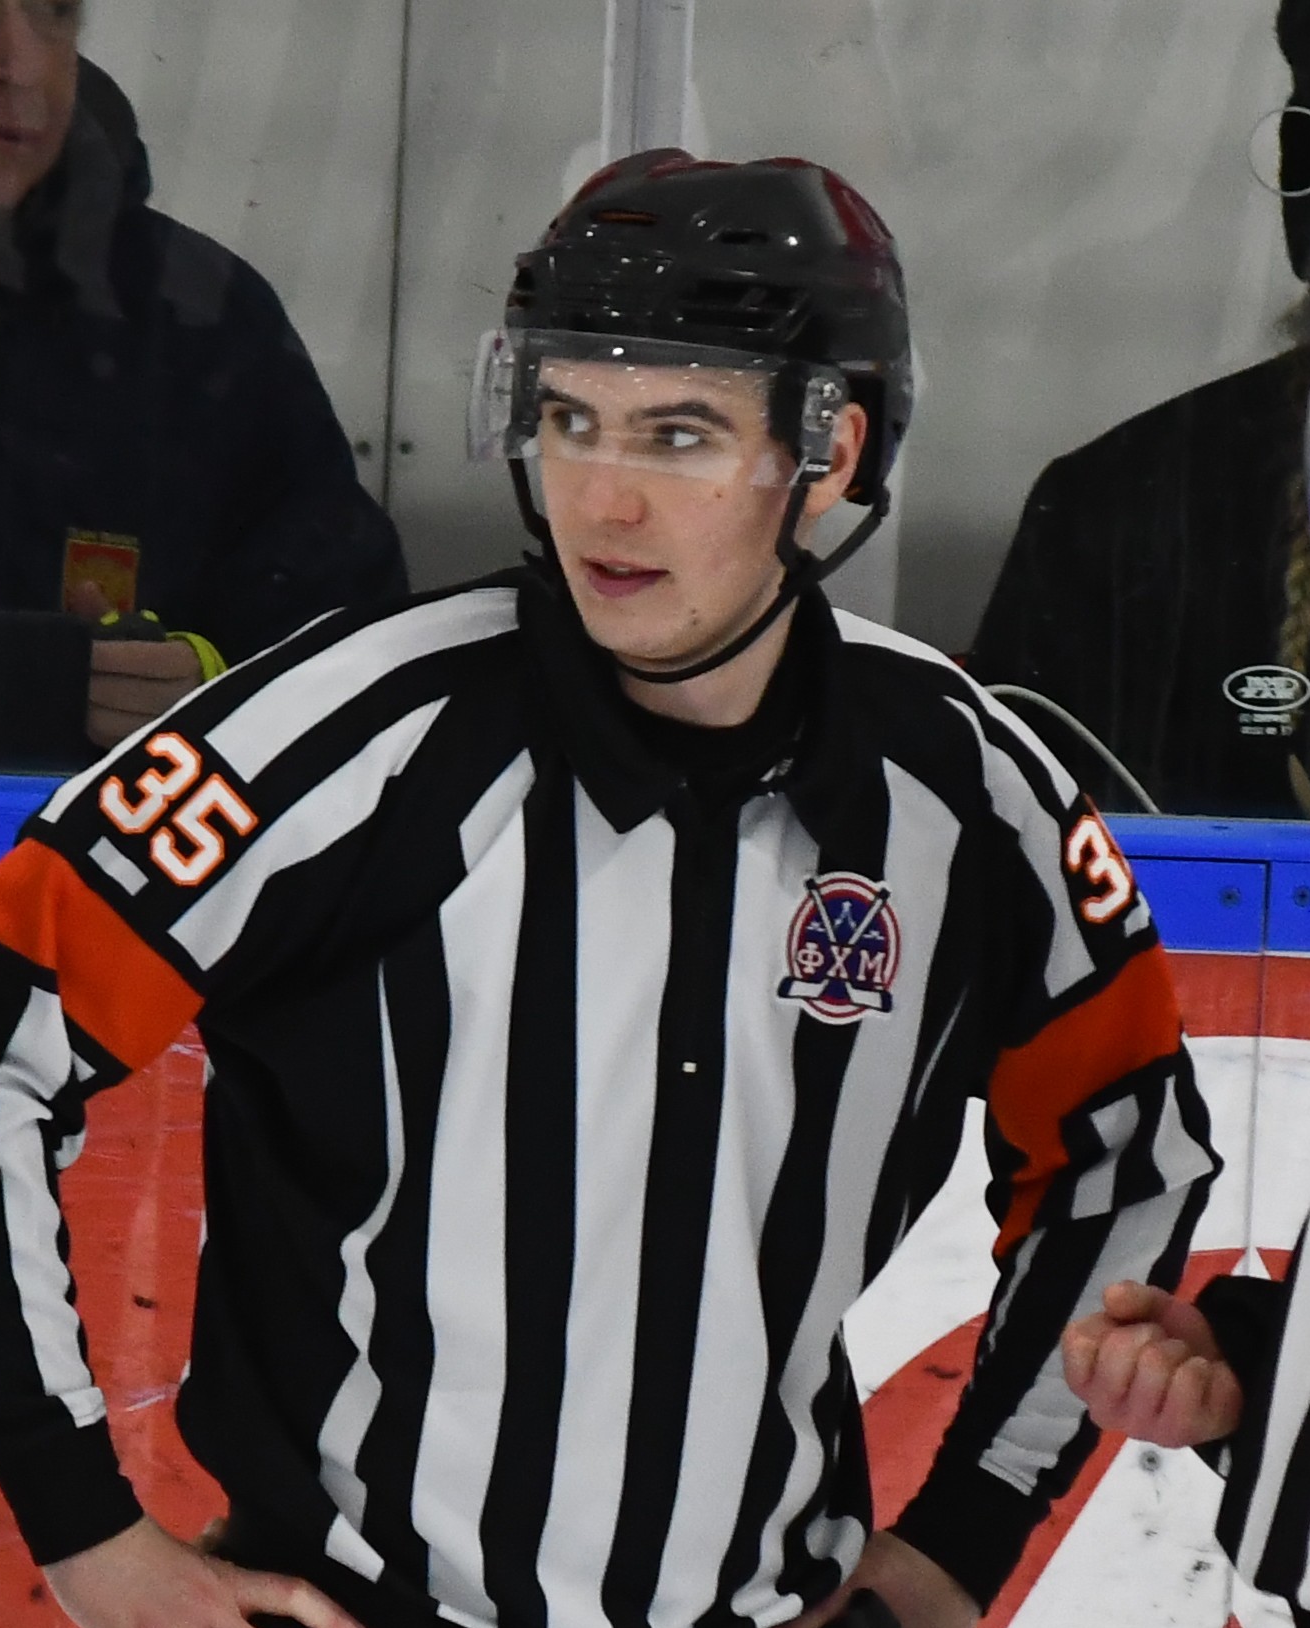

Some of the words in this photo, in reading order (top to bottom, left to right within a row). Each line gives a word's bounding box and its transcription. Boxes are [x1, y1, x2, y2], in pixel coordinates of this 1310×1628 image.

[99, 732, 259, 887] 35
[1067, 814, 1134, 923] 3
[797, 942, 886, 983] ФХМ
